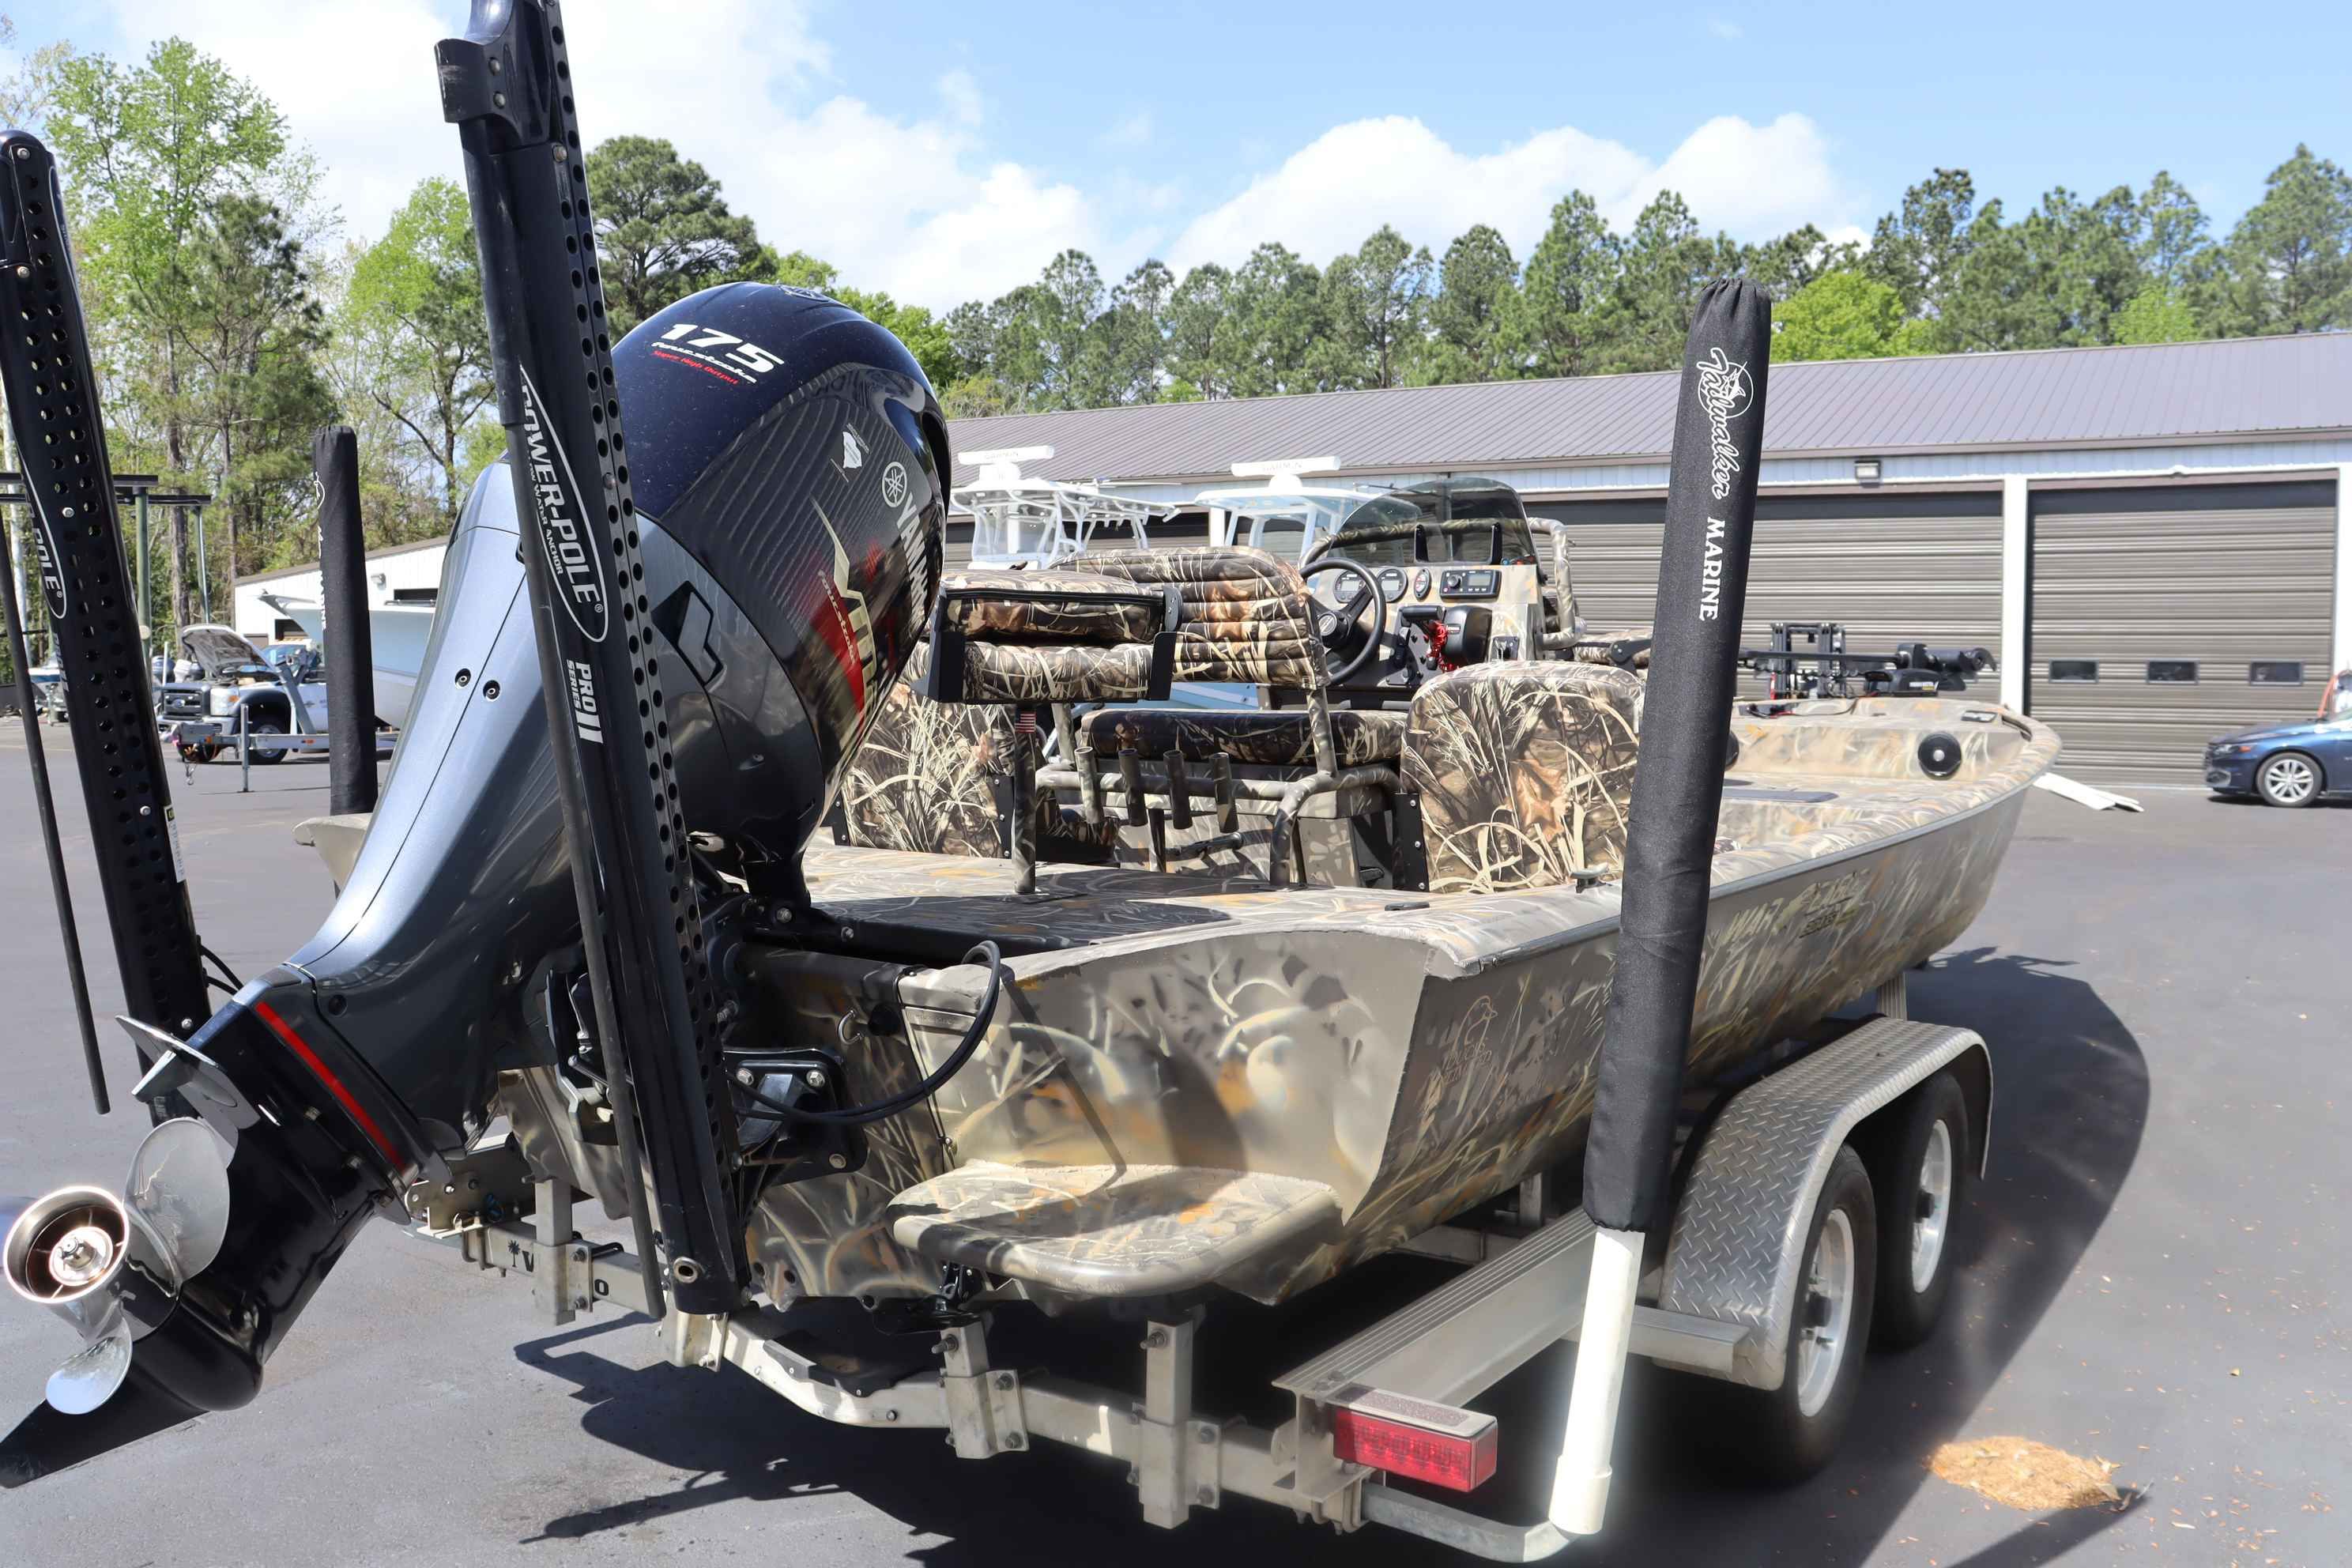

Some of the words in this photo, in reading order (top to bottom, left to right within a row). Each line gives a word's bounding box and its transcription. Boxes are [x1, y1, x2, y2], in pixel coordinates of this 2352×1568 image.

[660, 323, 786, 374] 175
[680, 356, 703, 369] High
[703, 366, 741, 385] Output
[545, 527, 564, 575] ANCHOR
[1698, 515, 1726, 622] MARINE
[566, 658, 582, 710] SERIES
[575, 662, 597, 713] PRO
